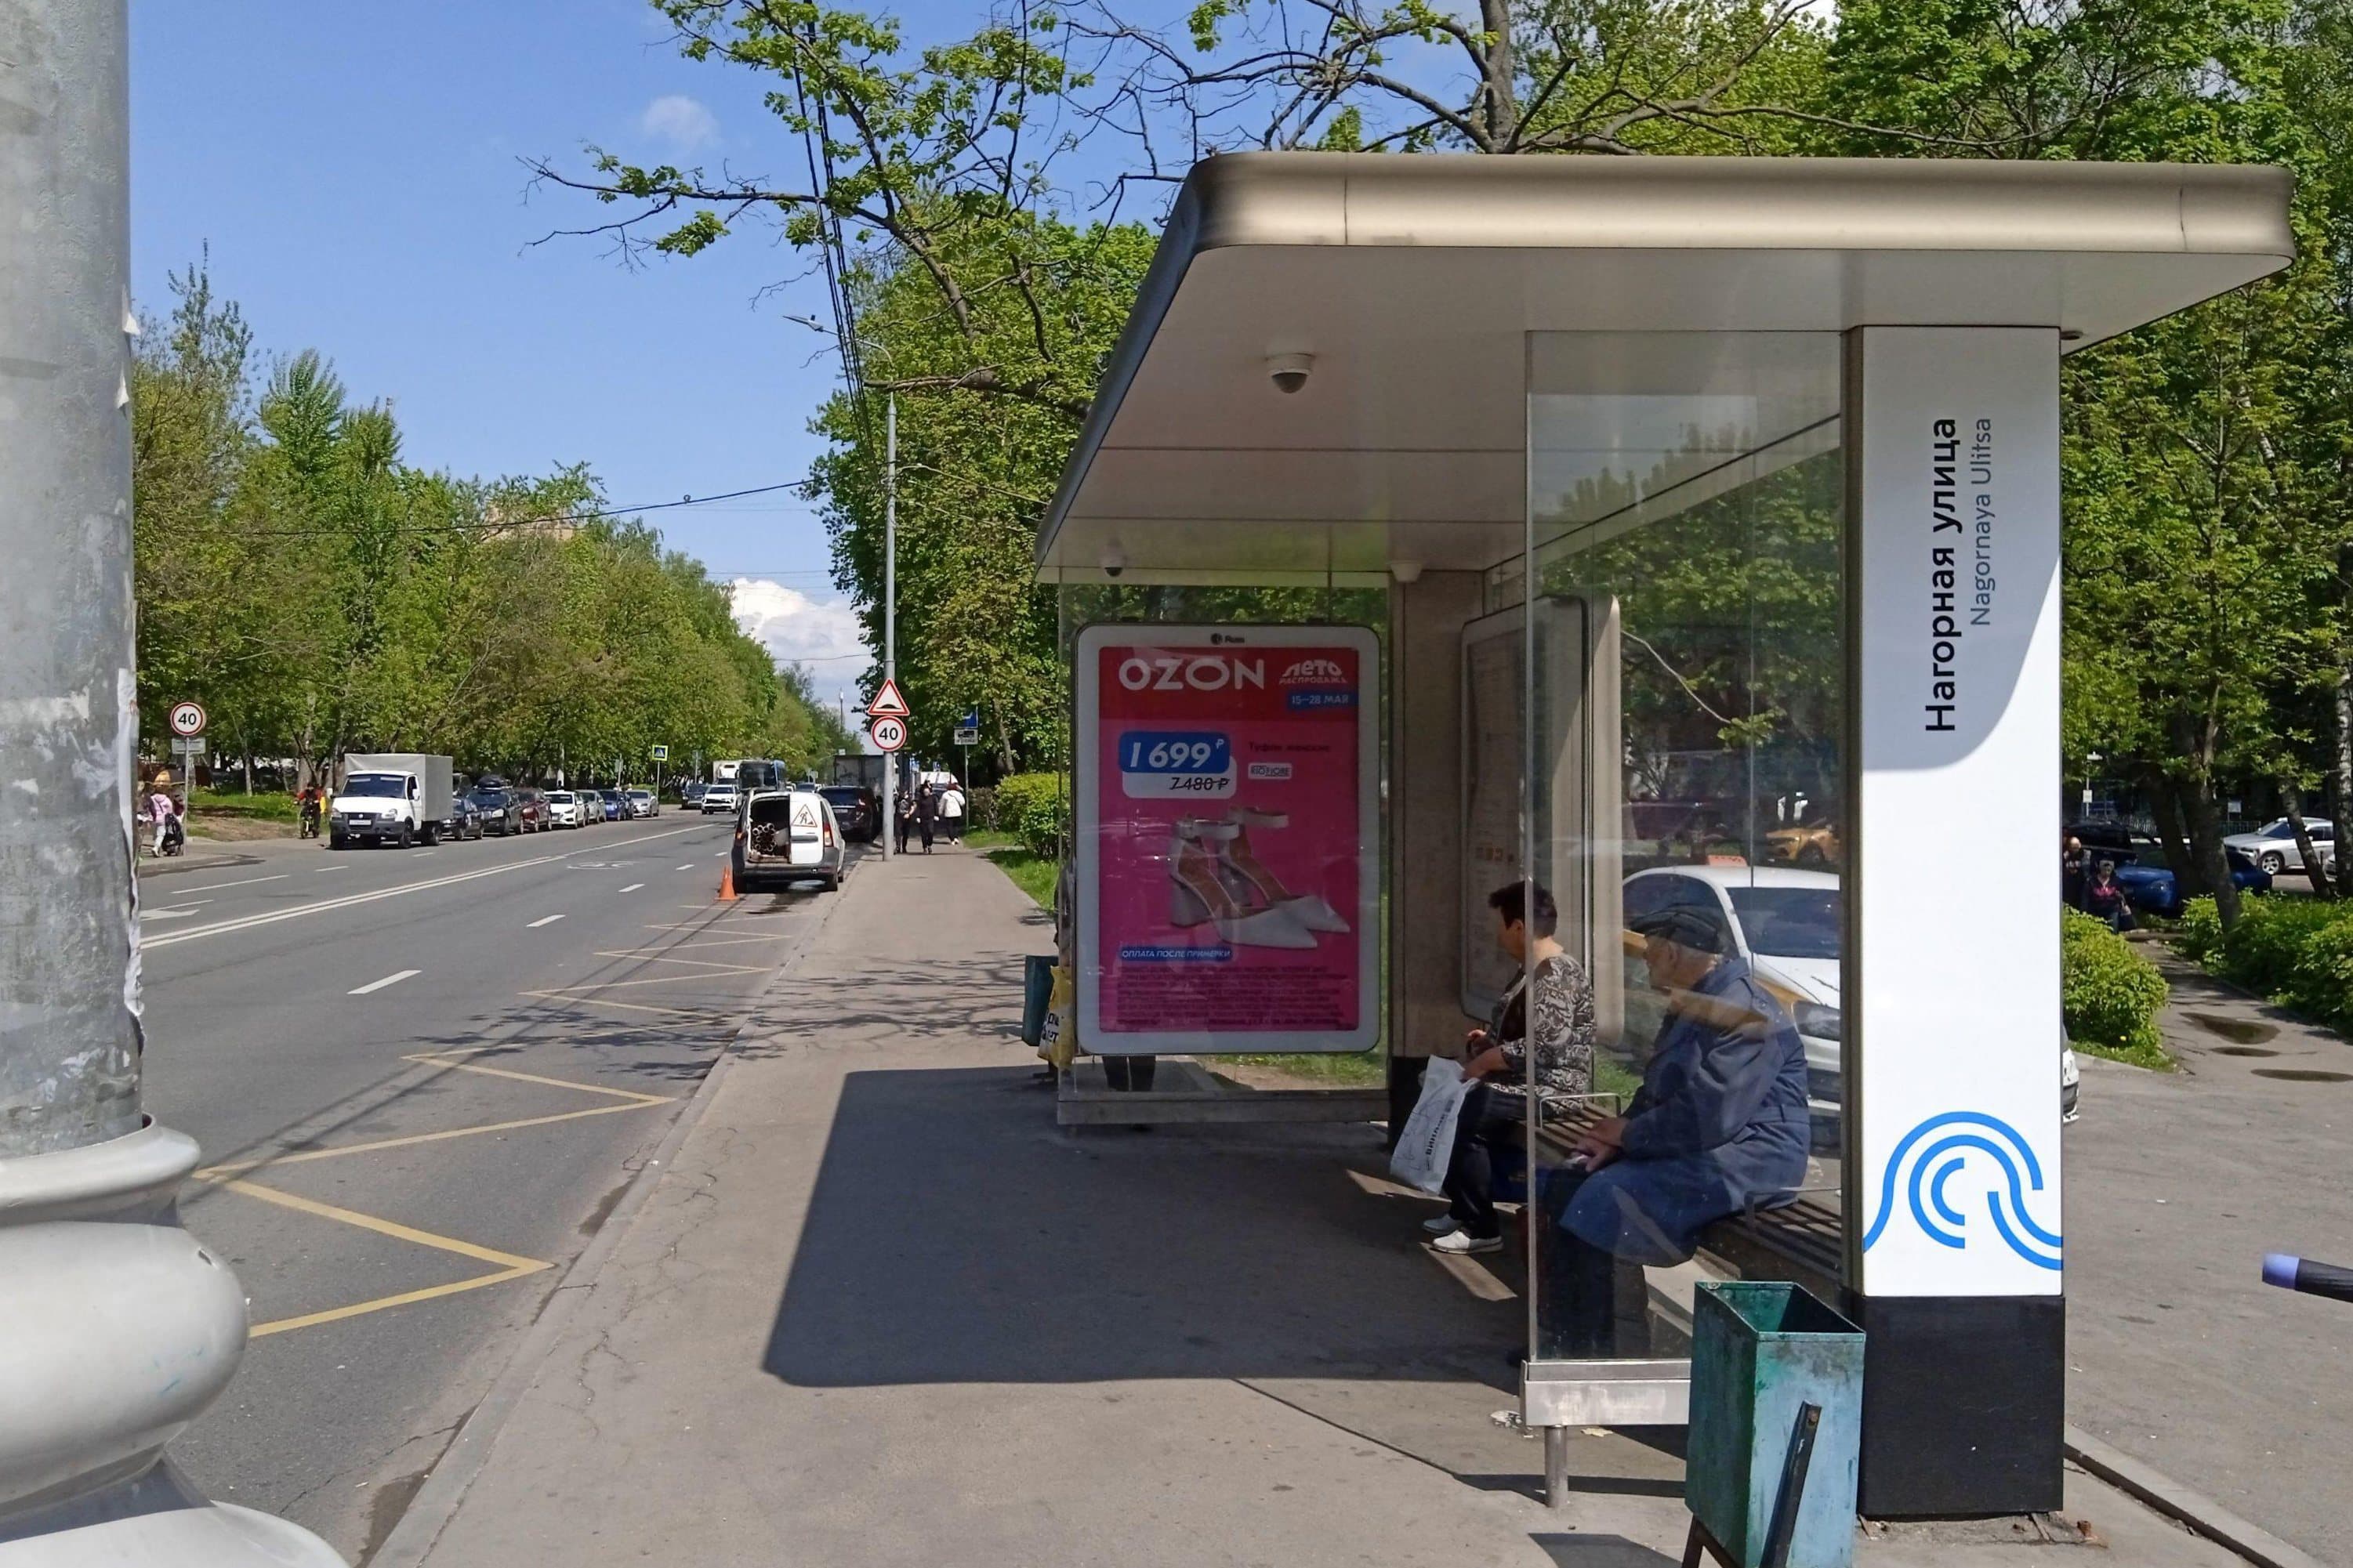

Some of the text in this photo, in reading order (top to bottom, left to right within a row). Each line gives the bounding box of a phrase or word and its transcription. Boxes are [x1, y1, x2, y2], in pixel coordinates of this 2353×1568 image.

[1971, 418, 1996, 625] Nagornaya Ulitsa
[1925, 418, 1963, 731] Нагорная улица
[1118, 657, 1264, 690] OZON
[178, 712, 198, 726] 40
[879, 726, 899, 741] 40
